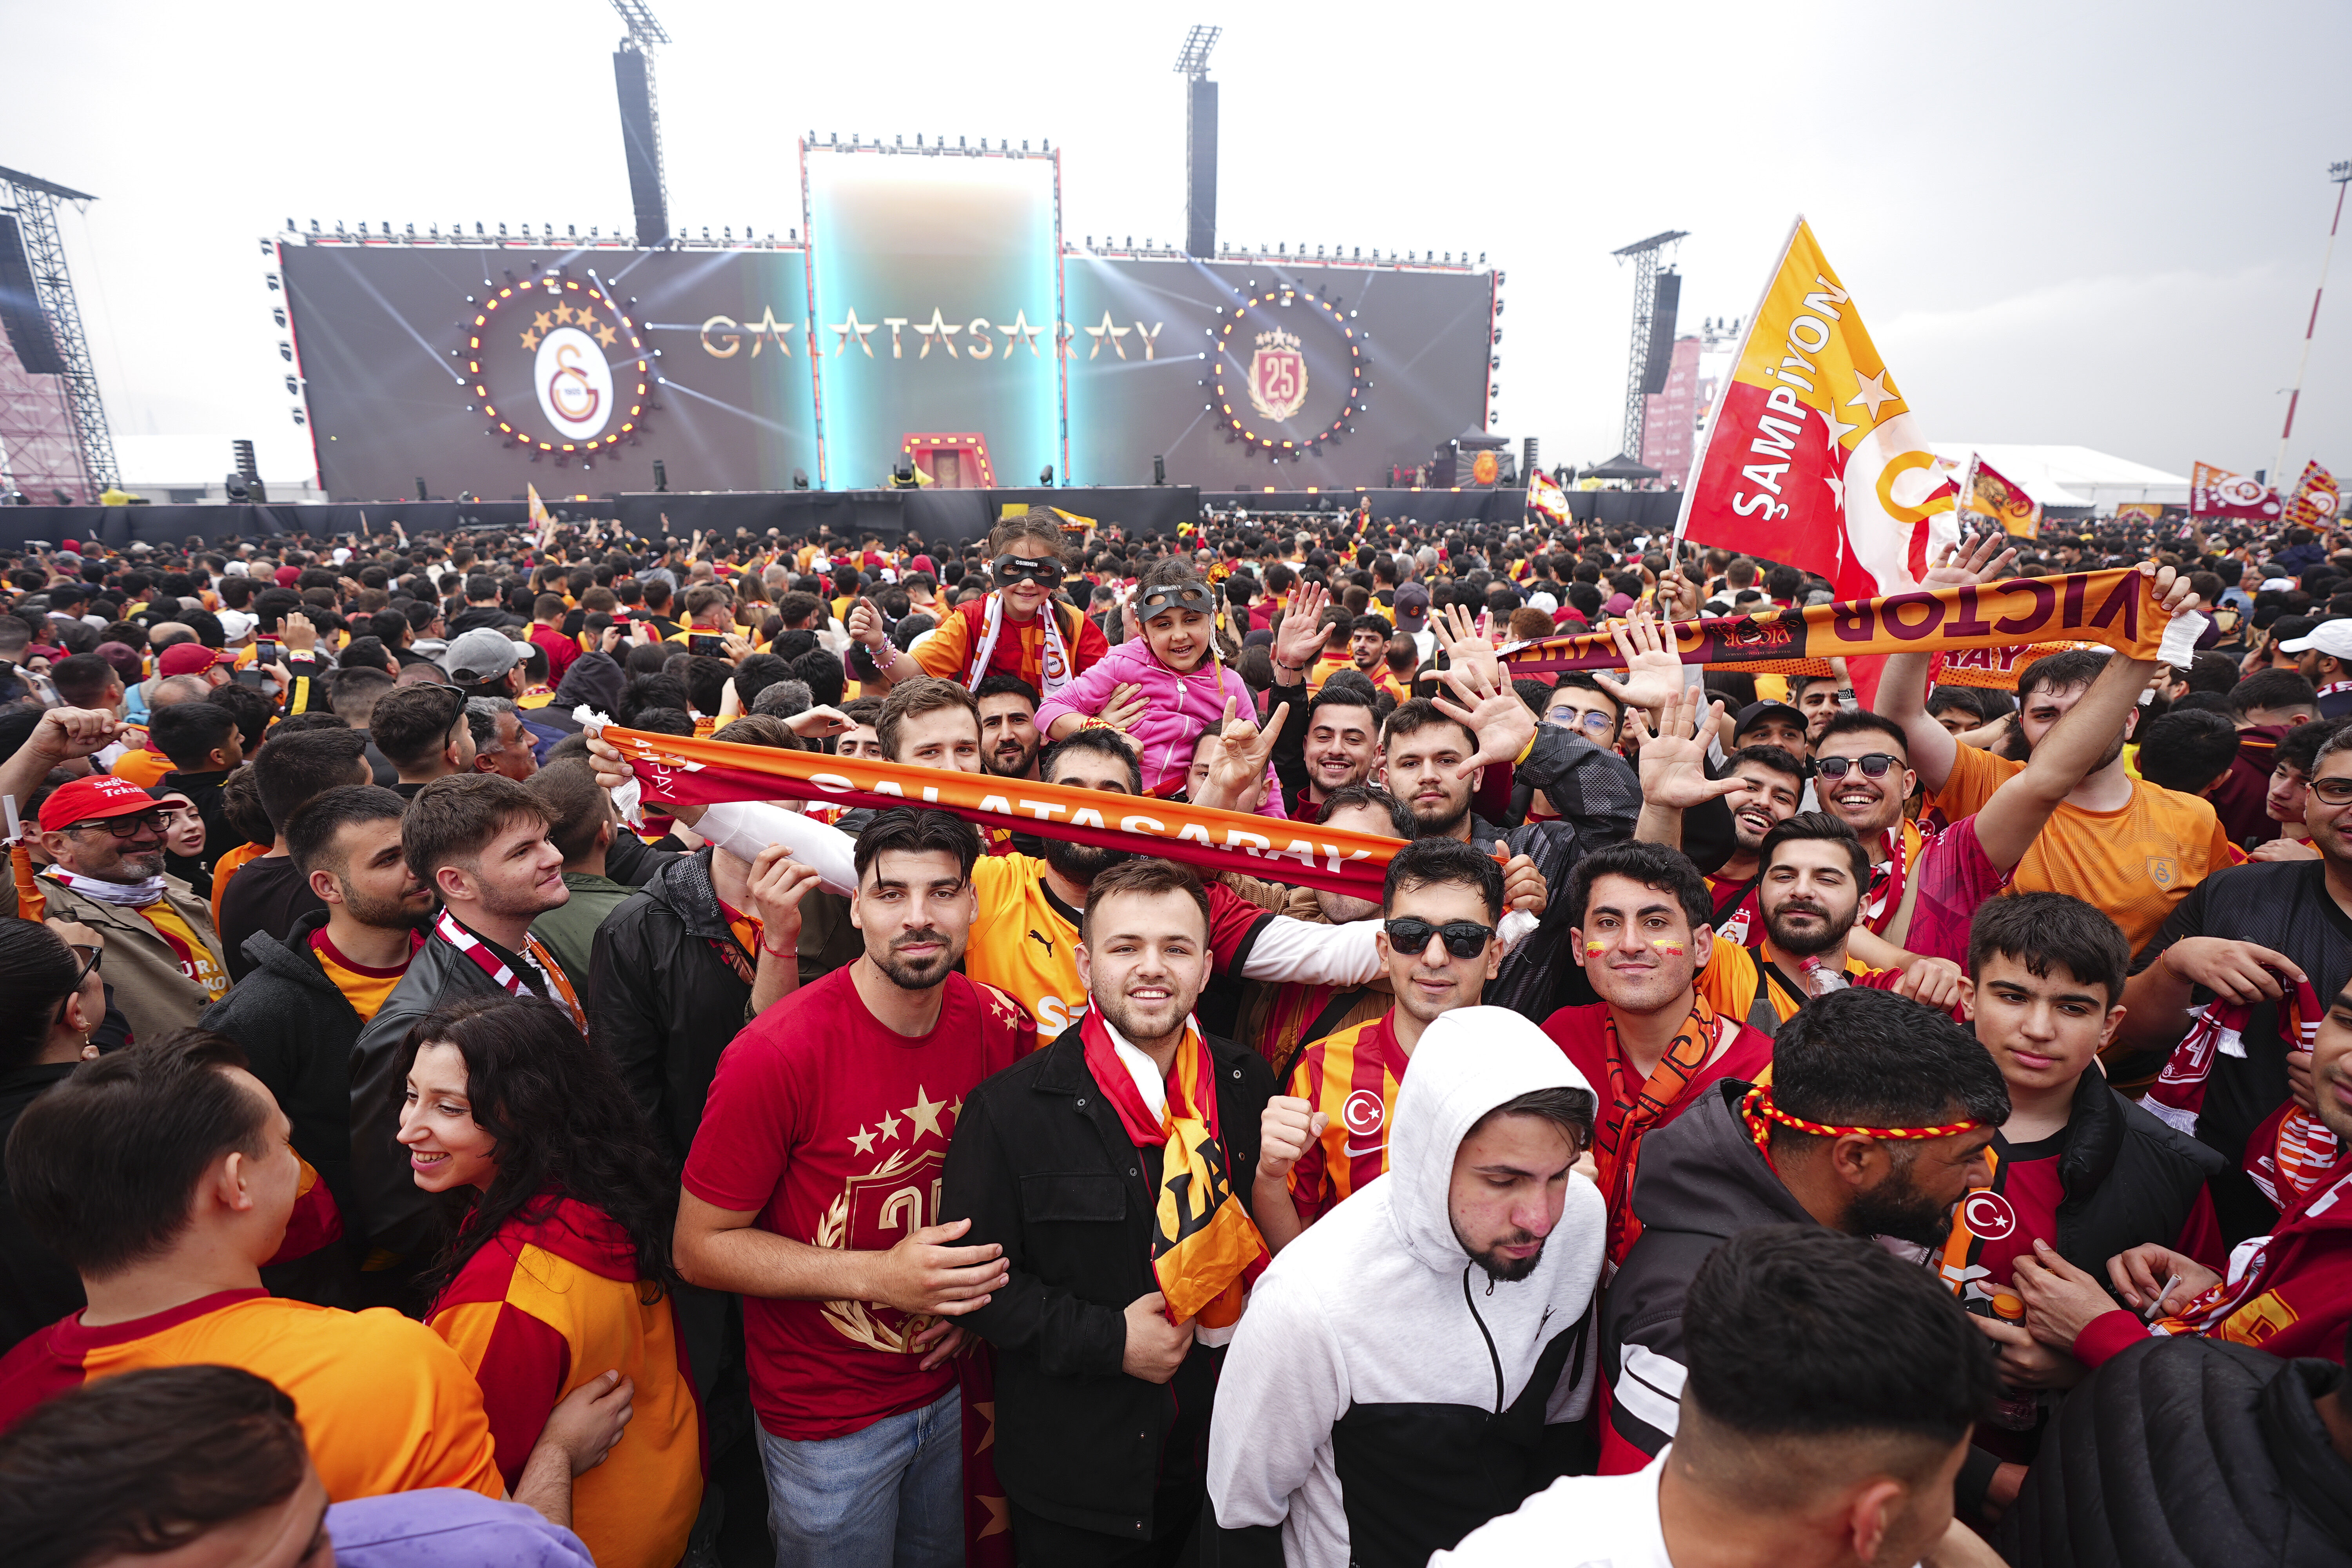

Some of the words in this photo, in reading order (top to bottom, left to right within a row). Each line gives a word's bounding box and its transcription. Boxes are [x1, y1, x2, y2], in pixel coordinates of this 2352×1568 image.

[1265, 357, 1294, 400] 25
[1732, 273, 1849, 521] ŞAMPİYON
[1829, 570, 2141, 643] VICTOR
